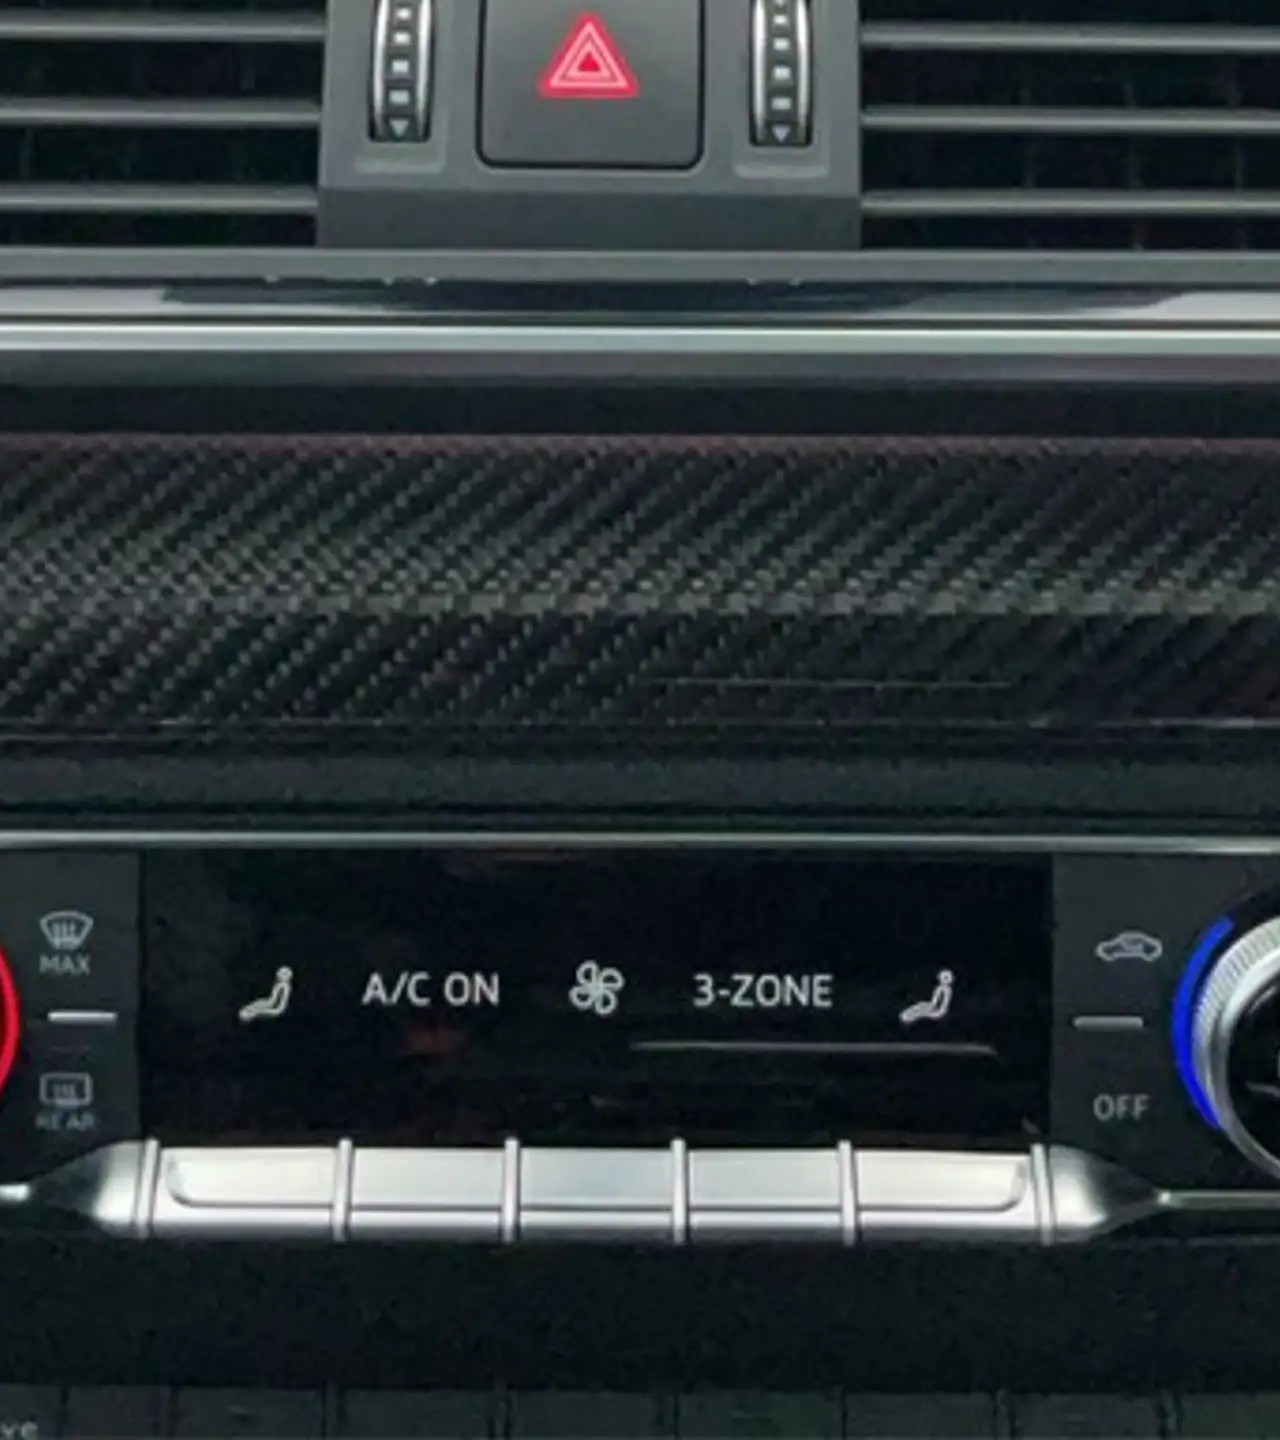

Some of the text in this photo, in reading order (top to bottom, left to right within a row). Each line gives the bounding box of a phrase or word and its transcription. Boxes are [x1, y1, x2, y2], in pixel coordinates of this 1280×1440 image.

[38, 954, 91, 976] MAX
[360, 971, 502, 1009] A/C ON
[692, 972, 834, 1009] 3-ZONE
[1092, 1094, 1151, 1122] OFF
